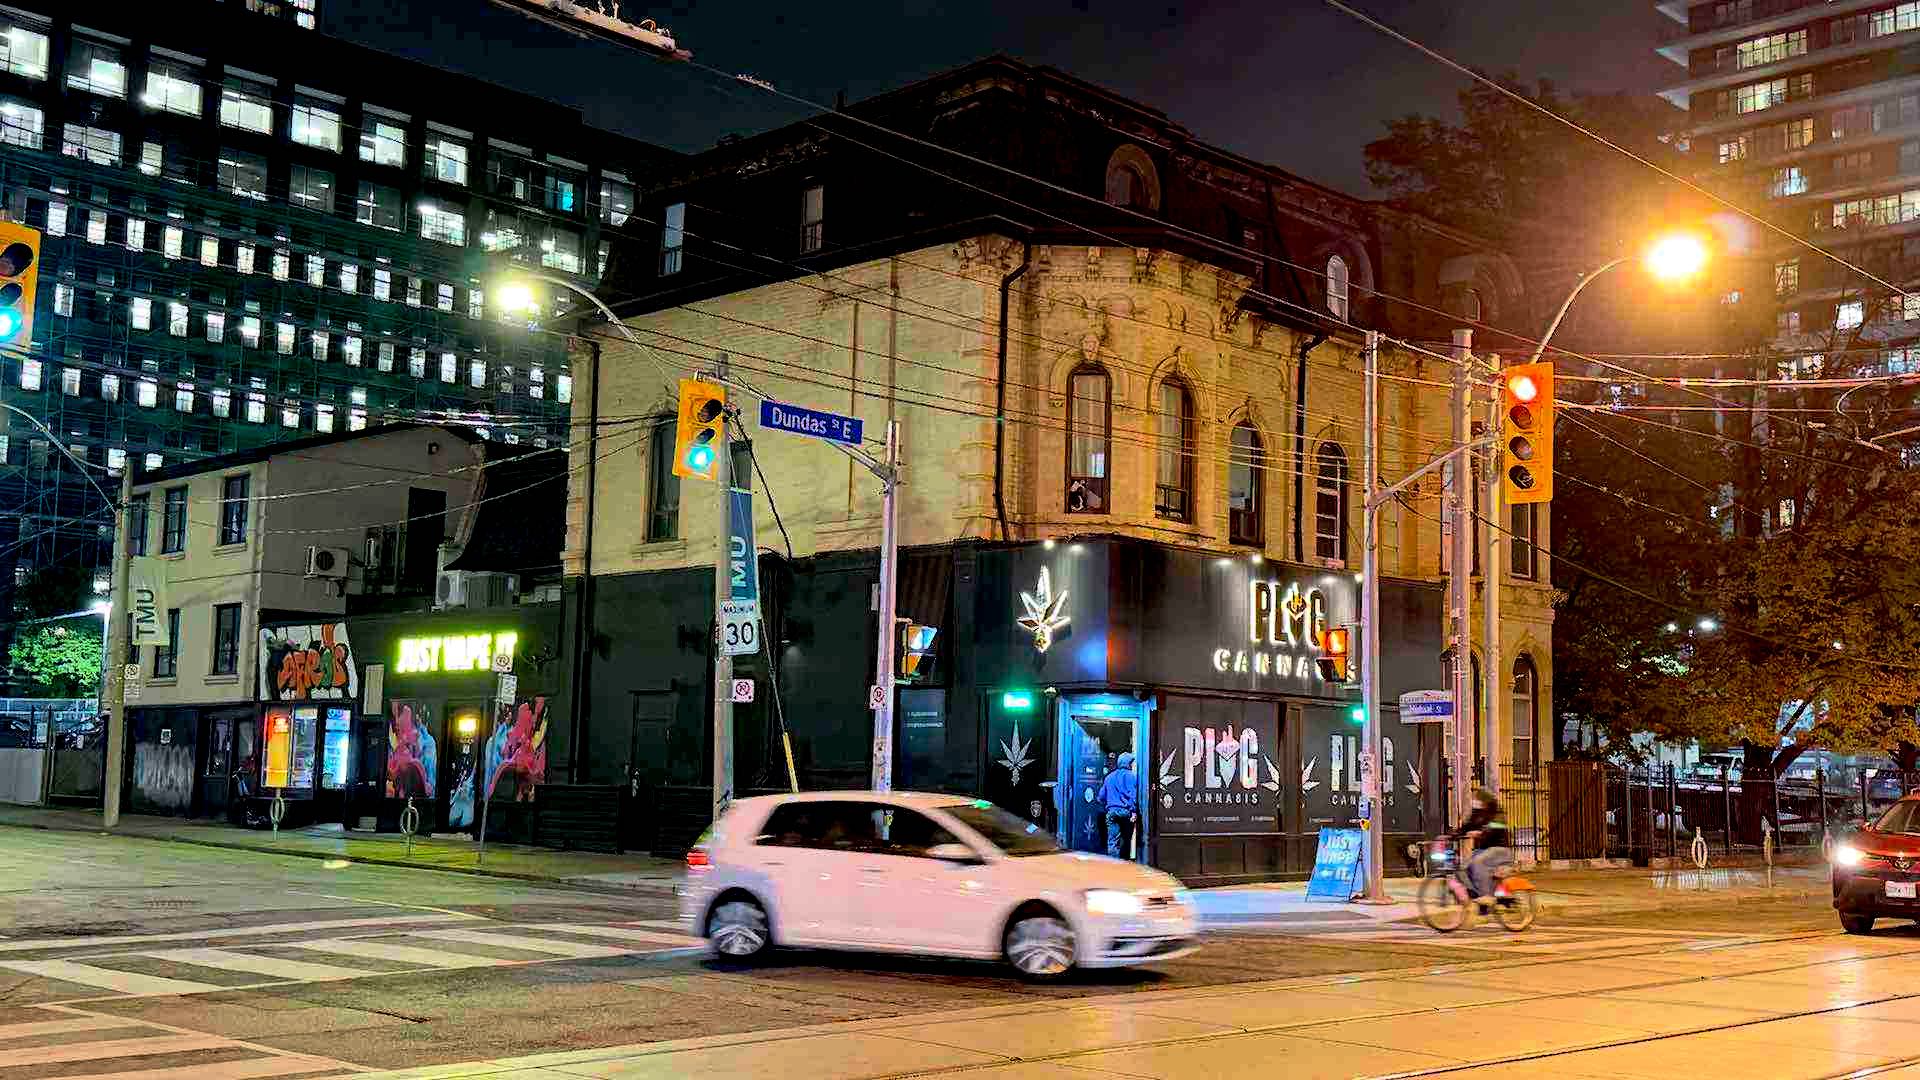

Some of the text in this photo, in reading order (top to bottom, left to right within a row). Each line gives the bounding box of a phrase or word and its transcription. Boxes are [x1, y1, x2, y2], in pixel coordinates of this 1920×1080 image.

[772, 406, 827, 435] Dundas
[843, 420, 852, 440] E
[731, 535, 747, 600] MU
[136, 588, 156, 640] TMU
[726, 621, 754, 646] 30
[1250, 579, 1329, 650] PLUG
[398, 636, 442, 673] JUST
[1184, 725, 1258, 789] PLUG
[1331, 735, 1394, 793] PLG
[1184, 792, 1259, 805] CANNABIS
